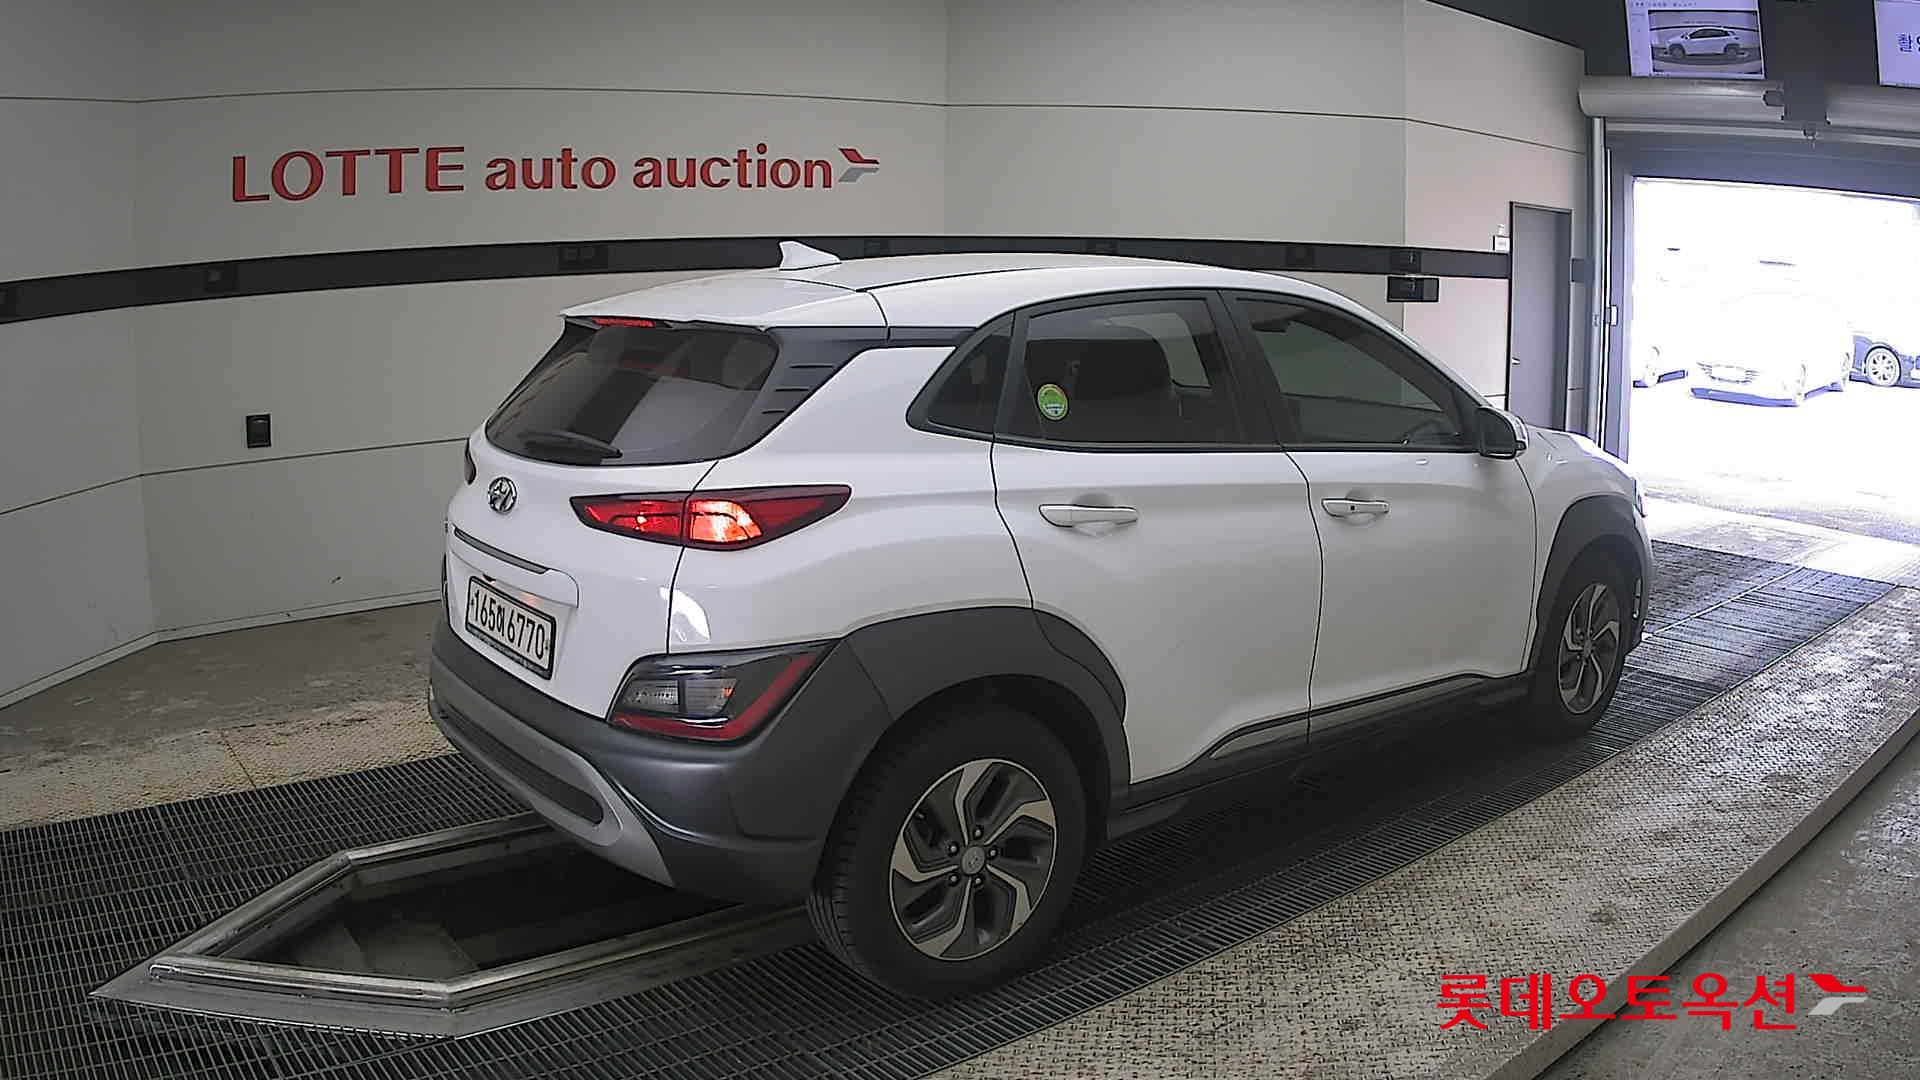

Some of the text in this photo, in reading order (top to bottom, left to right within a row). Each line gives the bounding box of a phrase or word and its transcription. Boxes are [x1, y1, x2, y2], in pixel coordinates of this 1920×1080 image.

[232, 142, 834, 202] LOTTE auto auction
